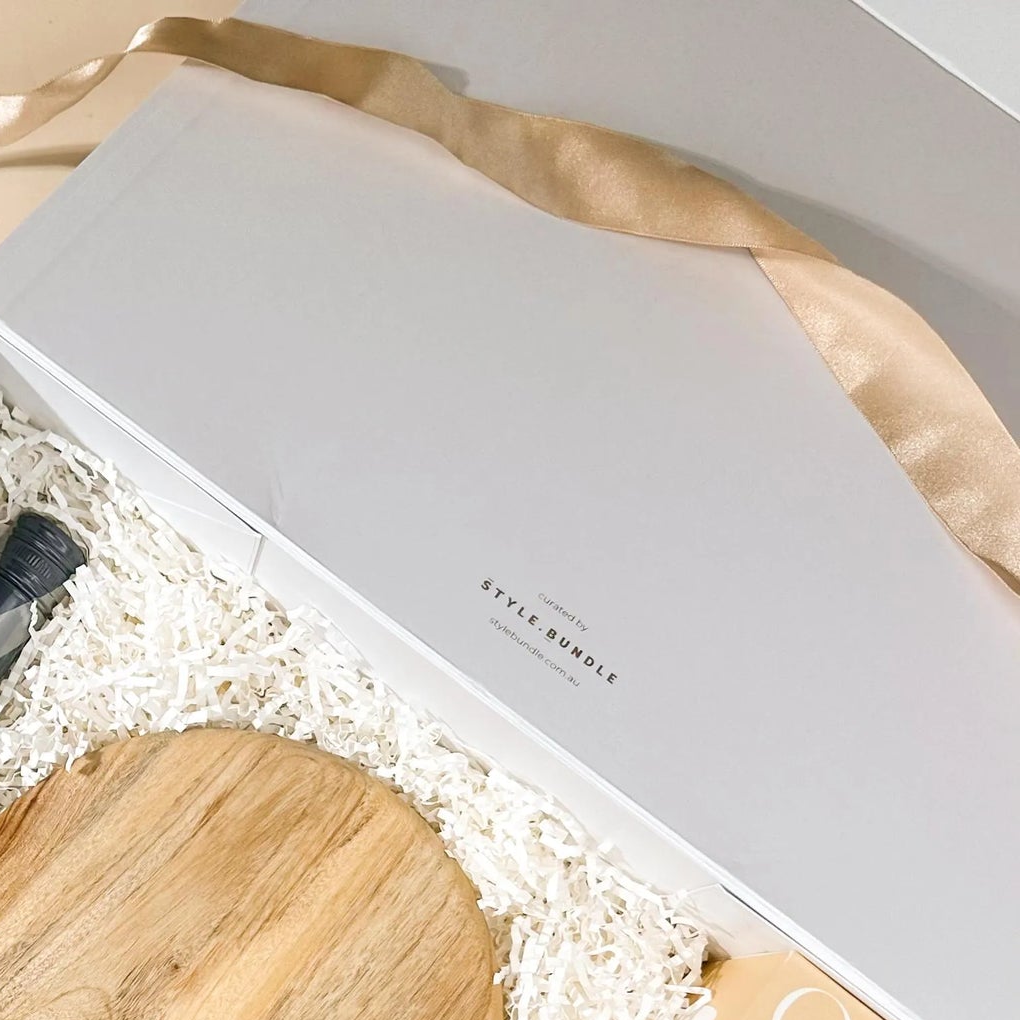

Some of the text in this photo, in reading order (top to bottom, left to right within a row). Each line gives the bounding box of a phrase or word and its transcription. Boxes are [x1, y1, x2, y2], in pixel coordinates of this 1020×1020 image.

[537, 592, 589, 632] curated by
[489, 617, 581, 687] stylebundle.com.au
